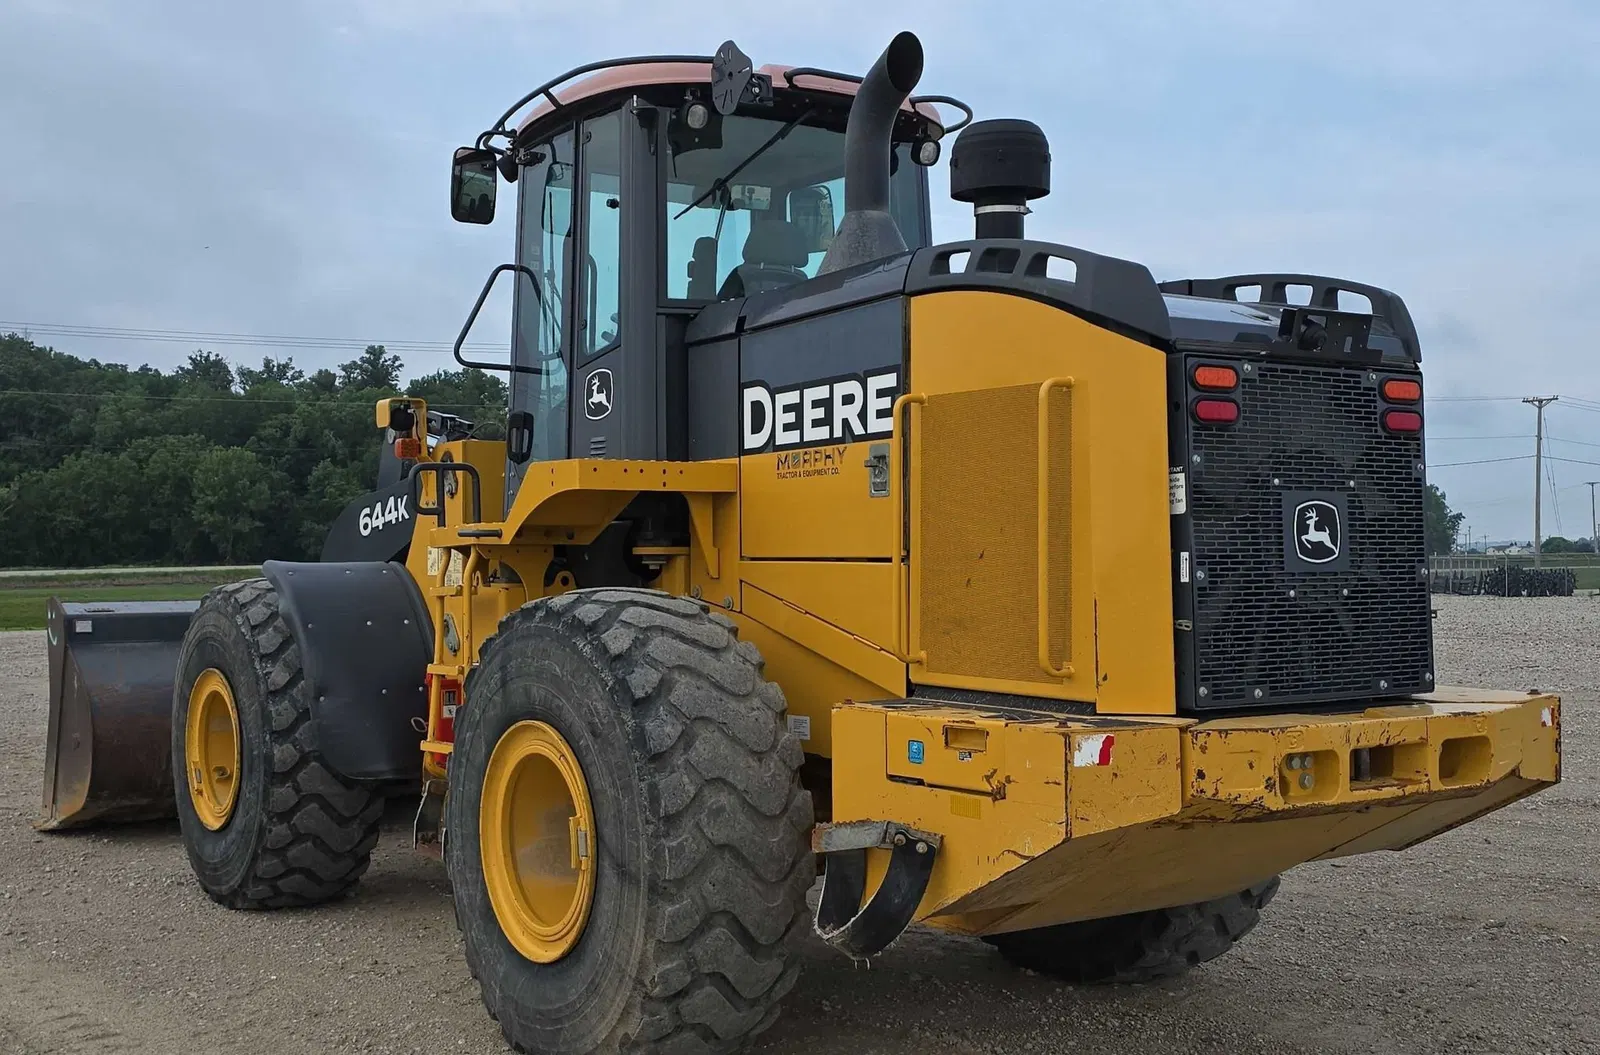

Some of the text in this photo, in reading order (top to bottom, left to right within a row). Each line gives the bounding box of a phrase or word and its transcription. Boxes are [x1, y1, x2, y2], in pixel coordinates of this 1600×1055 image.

[743, 372, 897, 449] DEERE
[776, 471, 798, 480] TRACTOR
[802, 467, 830, 478] EQUIPMENT
[359, 495, 410, 537] 644K
